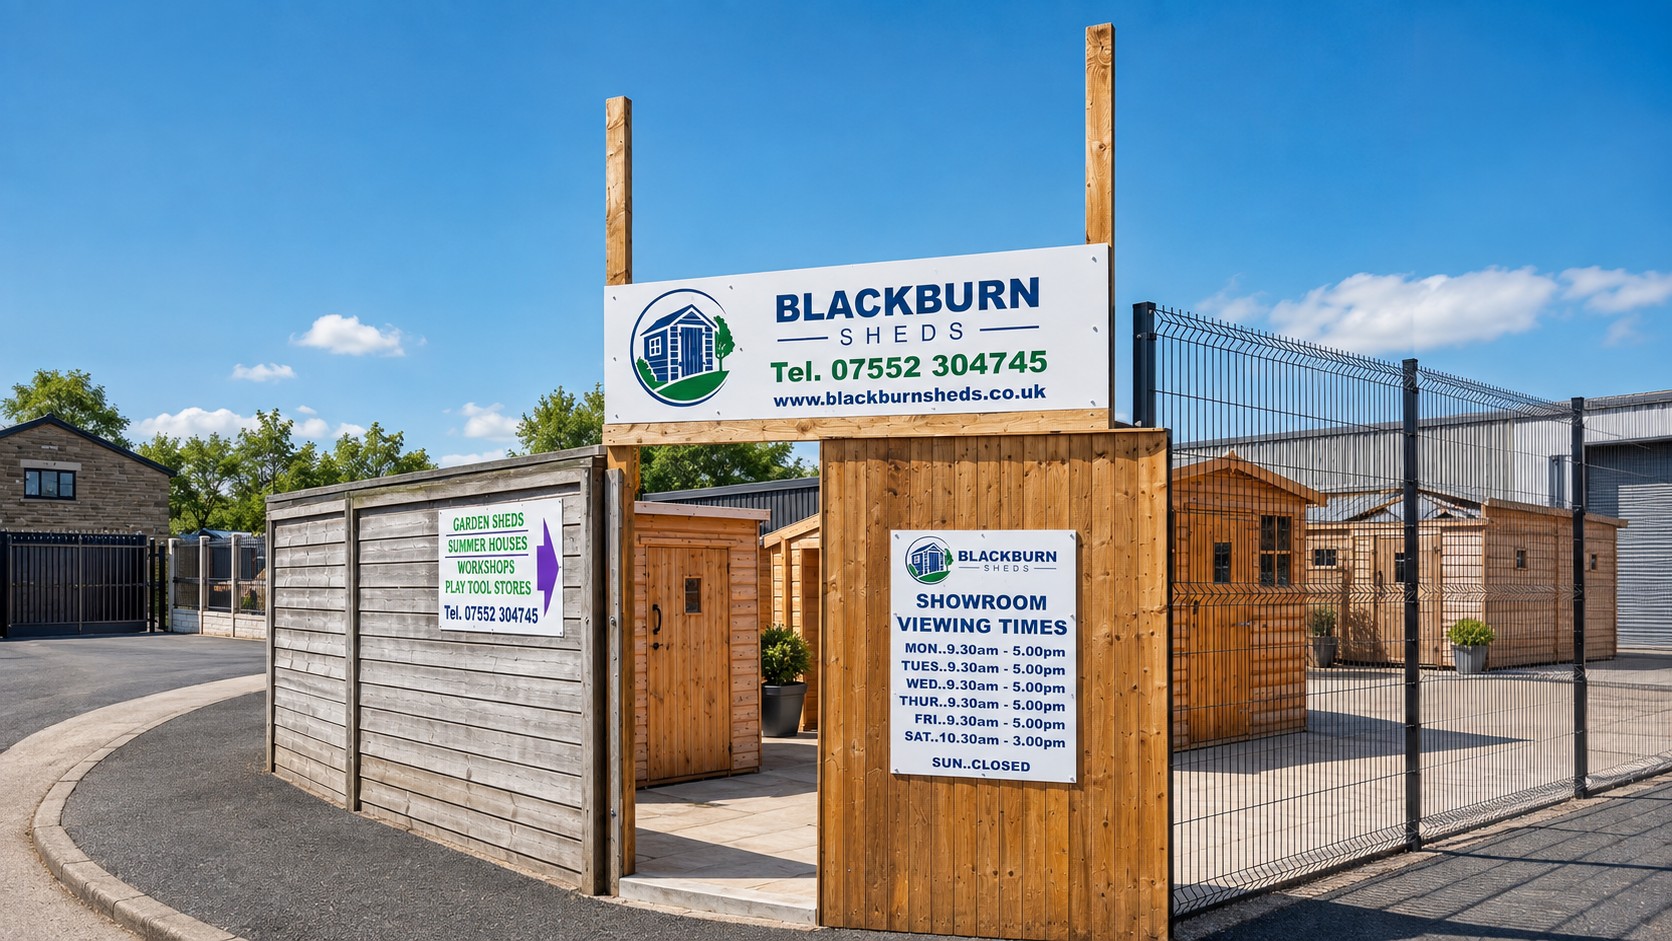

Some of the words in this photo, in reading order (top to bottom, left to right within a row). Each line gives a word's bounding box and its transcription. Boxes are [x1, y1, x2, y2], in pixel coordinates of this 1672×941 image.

[775, 276, 1040, 323] BLACKBURN
[840, 322, 964, 347] SHEDS
[770, 360, 822, 383] Tel.
[830, 355, 922, 382] 07552
[932, 350, 1048, 378] 304745
[773, 384, 1046, 408] www.blackburnsheds.co.uk
[453, 514, 490, 532] GARDEN
[492, 511, 524, 529] SHEDS
[448, 537, 486, 553] SUMMER
[488, 535, 528, 552] HOUSES
[958, 550, 1057, 563] BLACKBURN
[457, 559, 515, 575] WORKSHOPS
[984, 564, 1030, 573] SHEDS
[445, 580, 466, 594] PLAY
[468, 580, 492, 595] TOOL
[494, 580, 532, 595] STORES
[916, 593, 1048, 611] SHOWROOM
[444, 604, 462, 620] Tel.
[464, 605, 496, 622] 07552
[499, 606, 539, 624] 304745
[897, 615, 991, 634] VIEWING
[999, 618, 1068, 636] TIMES
[905, 642, 999, 656] MON..9.30am
[1012, 645, 1066, 659] 5.00pm
[901, 660, 999, 674] TUES..9.30am
[1012, 663, 1066, 677] 5.00pm
[906, 678, 999, 692] WED..9.30am
[1012, 681, 1066, 695] 5.00pm
[899, 696, 999, 709] THUR..9.30am
[1012, 699, 1066, 713] 5.00pm
[914, 714, 999, 727] FRI..9.30am
[1012, 717, 1066, 731] 5.00pm
[904, 731, 999, 745] SAT..10.30am
[1012, 735, 1066, 749] 3.00pm
[932, 757, 1031, 773] SUN..CLOSED
